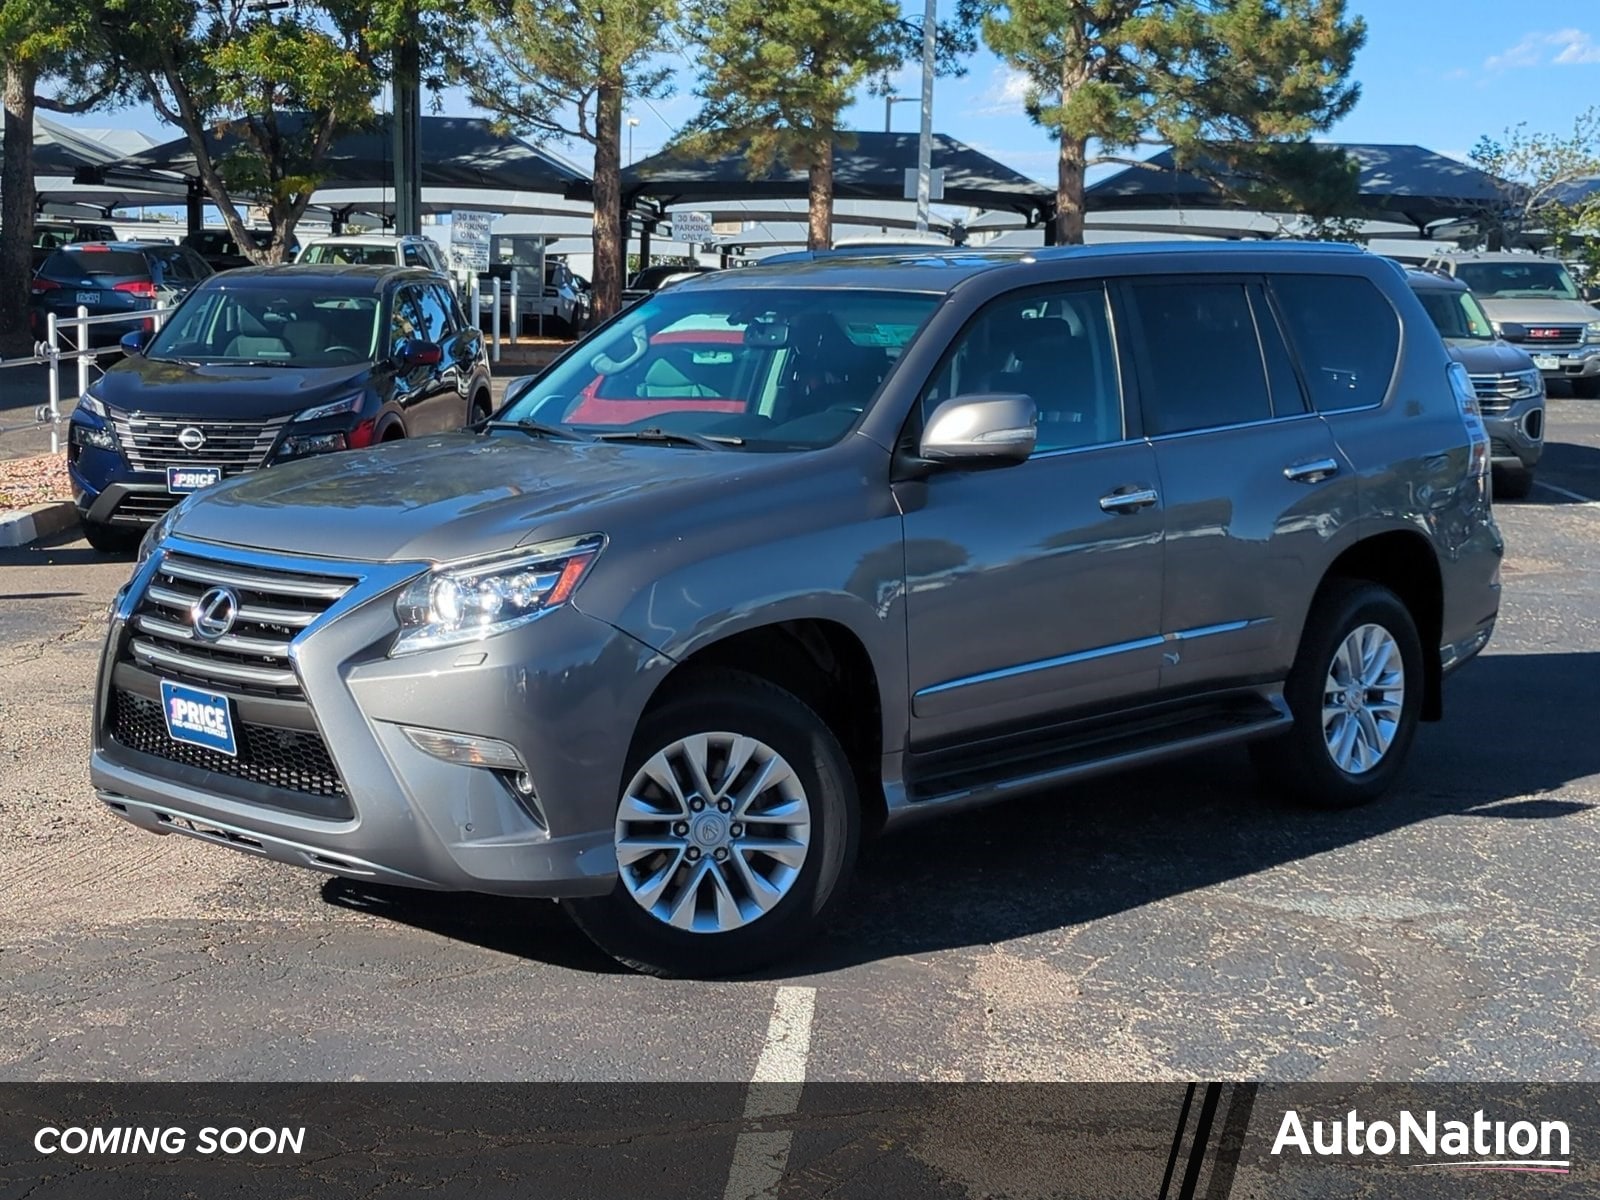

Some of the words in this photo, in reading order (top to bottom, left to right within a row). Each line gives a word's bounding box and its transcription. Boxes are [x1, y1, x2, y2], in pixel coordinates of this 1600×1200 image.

[457, 213, 467, 221] 30
[678, 214, 688, 222] 30
[454, 222, 489, 231] PARKING
[674, 224, 710, 232] PARKING
[460, 231, 481, 240] ONLY
[681, 233, 703, 241] ONLY
